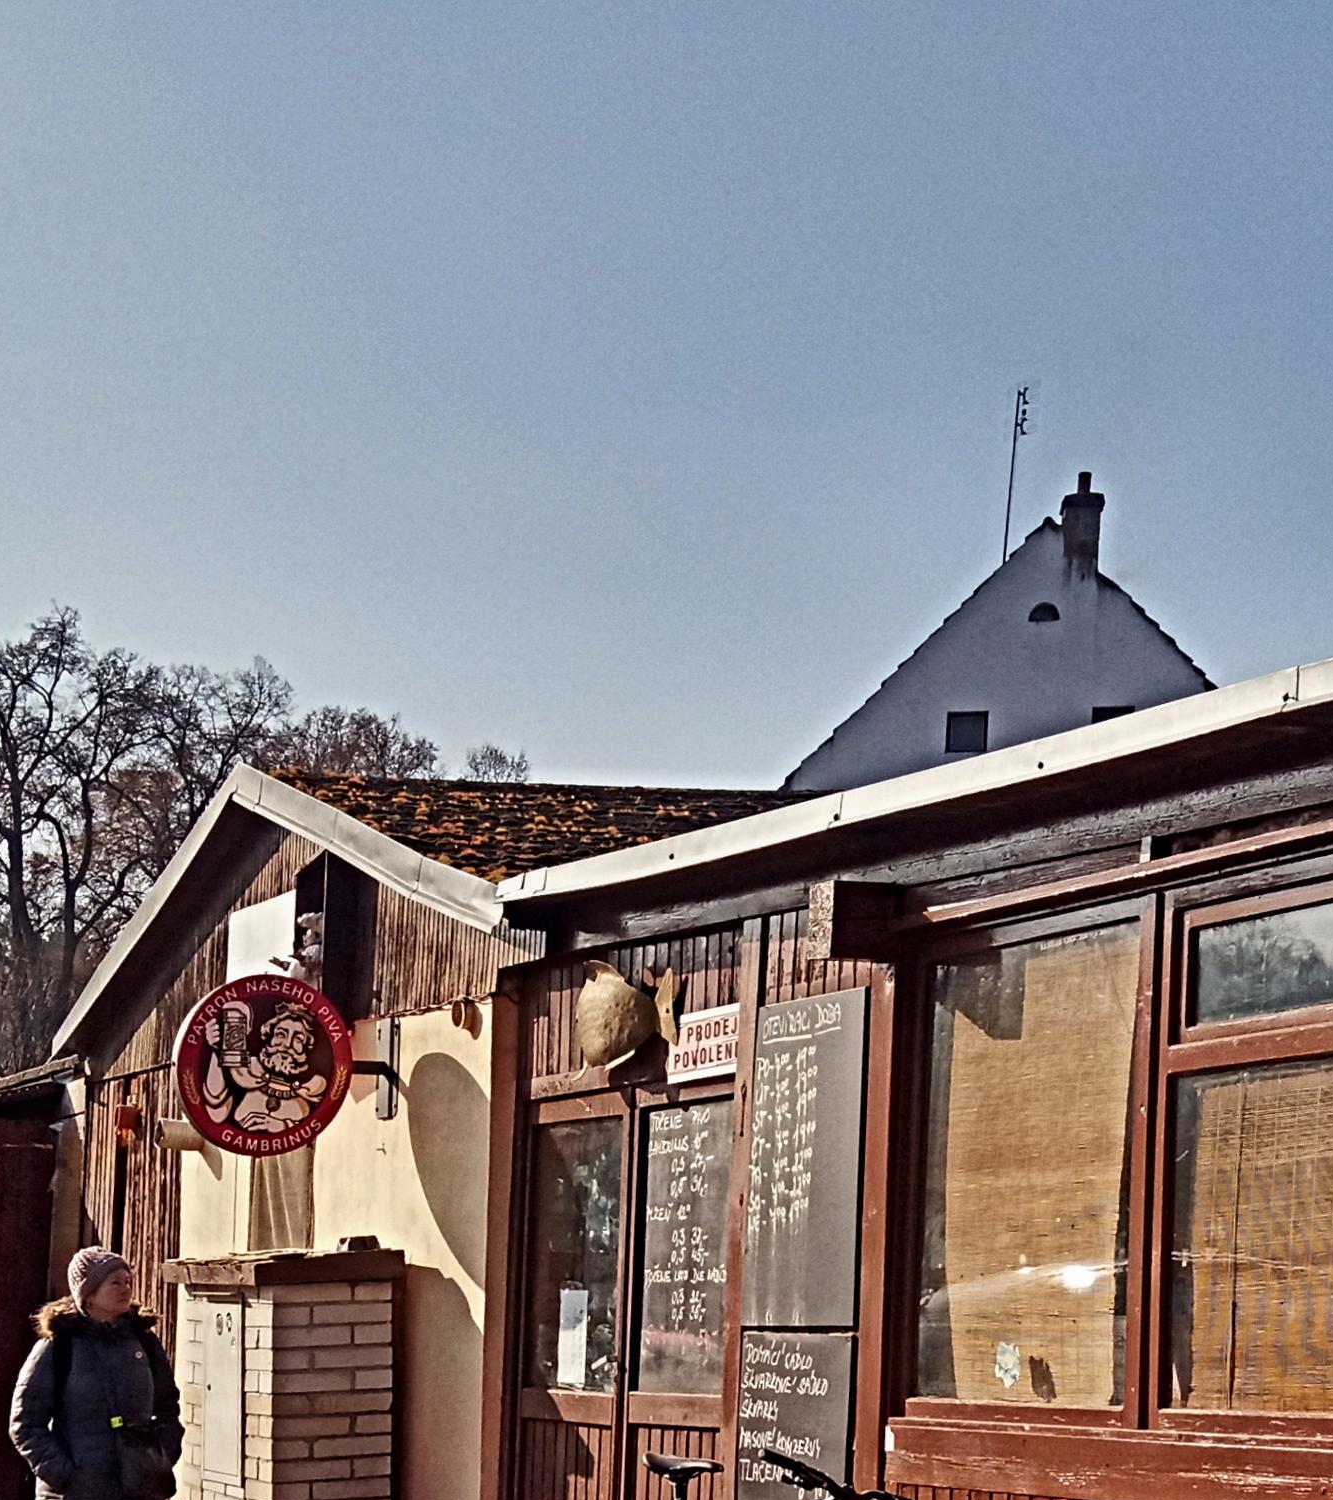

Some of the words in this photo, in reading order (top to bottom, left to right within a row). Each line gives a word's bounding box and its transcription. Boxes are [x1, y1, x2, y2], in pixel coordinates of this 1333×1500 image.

[187, 987, 238, 1045] PATRON
[246, 977, 315, 1004] NAŠEHO
[318, 1007, 343, 1044] PIVA
[687, 1017, 738, 1043] PRODEJ
[221, 1118, 322, 1151] GAMBRINUS
